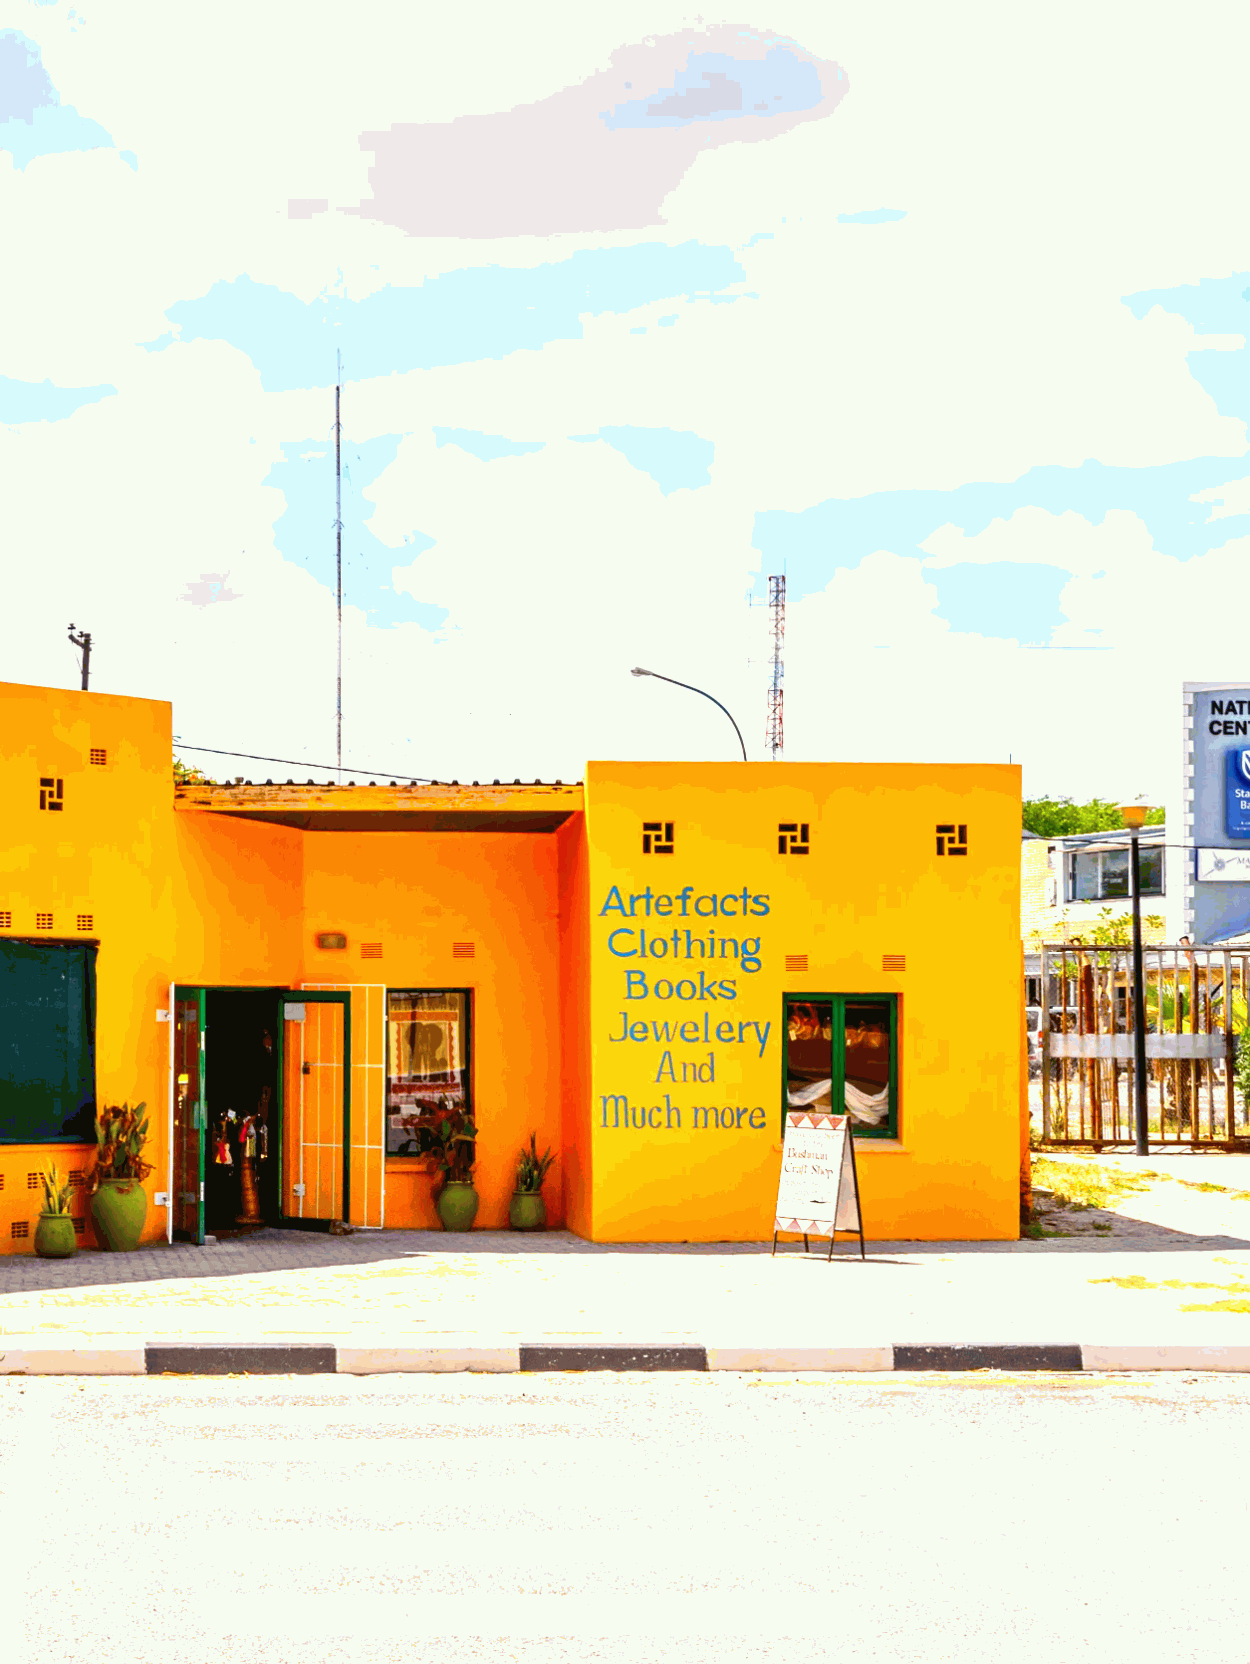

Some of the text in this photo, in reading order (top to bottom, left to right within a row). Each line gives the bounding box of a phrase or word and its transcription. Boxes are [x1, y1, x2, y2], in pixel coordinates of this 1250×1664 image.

[1209, 720, 1250, 736] CEN
[598, 885, 770, 917] Artefacts
[608, 928, 762, 973] Clothing
[623, 970, 737, 1001] Books
[609, 1011, 771, 1059] Jewelery
[654, 1050, 715, 1083] And
[600, 1094, 766, 1129] Much more
